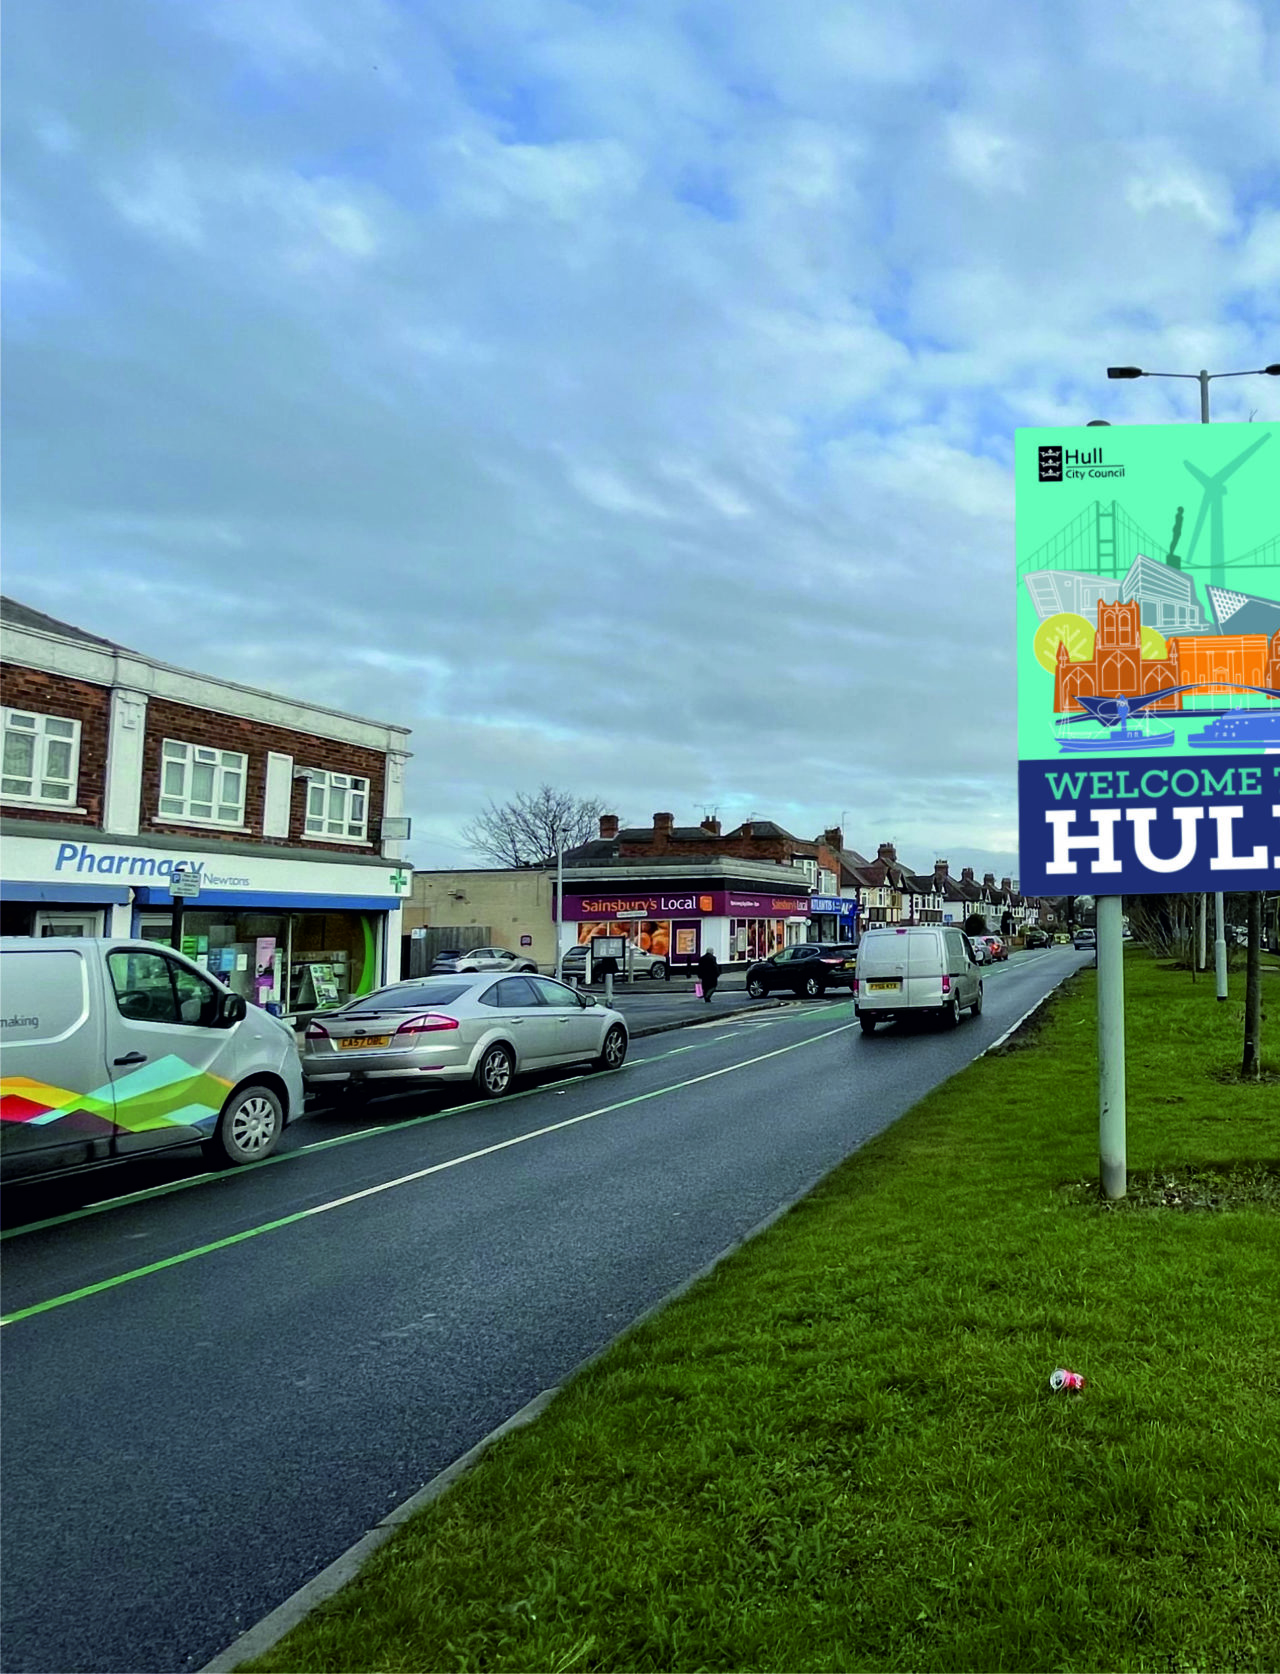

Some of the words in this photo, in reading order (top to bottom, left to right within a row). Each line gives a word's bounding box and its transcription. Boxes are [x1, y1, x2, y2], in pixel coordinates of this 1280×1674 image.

[1065, 447, 1103, 465] Hull
[1065, 469, 1086, 481] City
[1088, 467, 1126, 479] Council
[1045, 768, 1262, 800] WELCOME
[54, 843, 205, 877] Pharmacy
[203, 873, 250, 887] Newtons
[581, 898, 657, 913] Sainsbury's
[661, 895, 697, 910] Local
